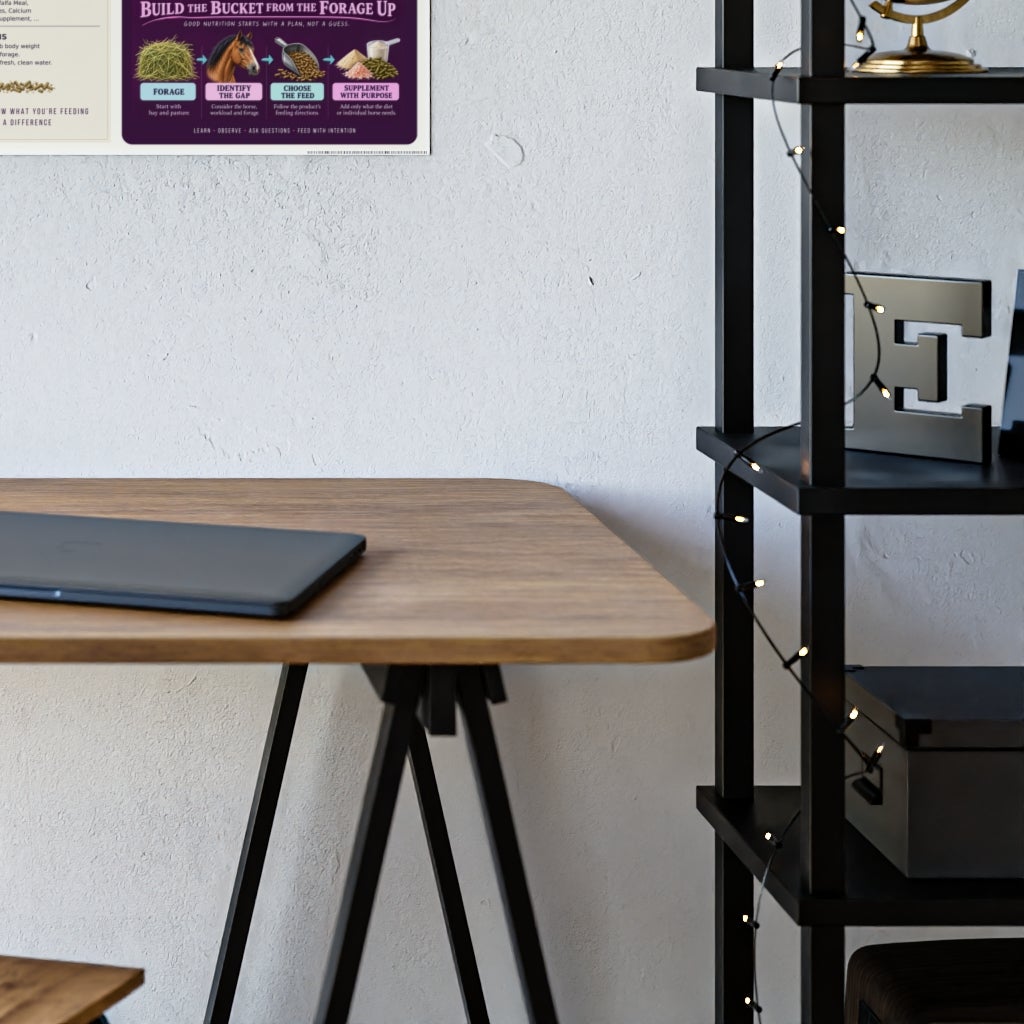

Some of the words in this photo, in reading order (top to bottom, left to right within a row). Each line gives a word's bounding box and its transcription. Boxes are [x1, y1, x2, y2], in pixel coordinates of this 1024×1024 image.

[140, 0, 185, 18] BUILD
[187, 3, 208, 13] THE
[210, 0, 264, 15] BUCKET
[266, 2, 296, 13] FROM
[297, 2, 317, 13] THE
[319, 0, 374, 15] FORAGE
[376, 0, 397, 17] UP
[153, 88, 185, 96] FORAGE
[217, 84, 251, 92] IDENTIFY
[283, 84, 312, 92] CHOOSE
[344, 84, 389, 92] SUPPLEMENT
[217, 92, 233, 100] THE
[235, 92, 252, 100] GAP
[279, 91, 295, 99] THE
[361, 91, 392, 99] PURPOSE
[9, 107, 29, 115] WHAT
[60, 107, 89, 116] FEEDING
